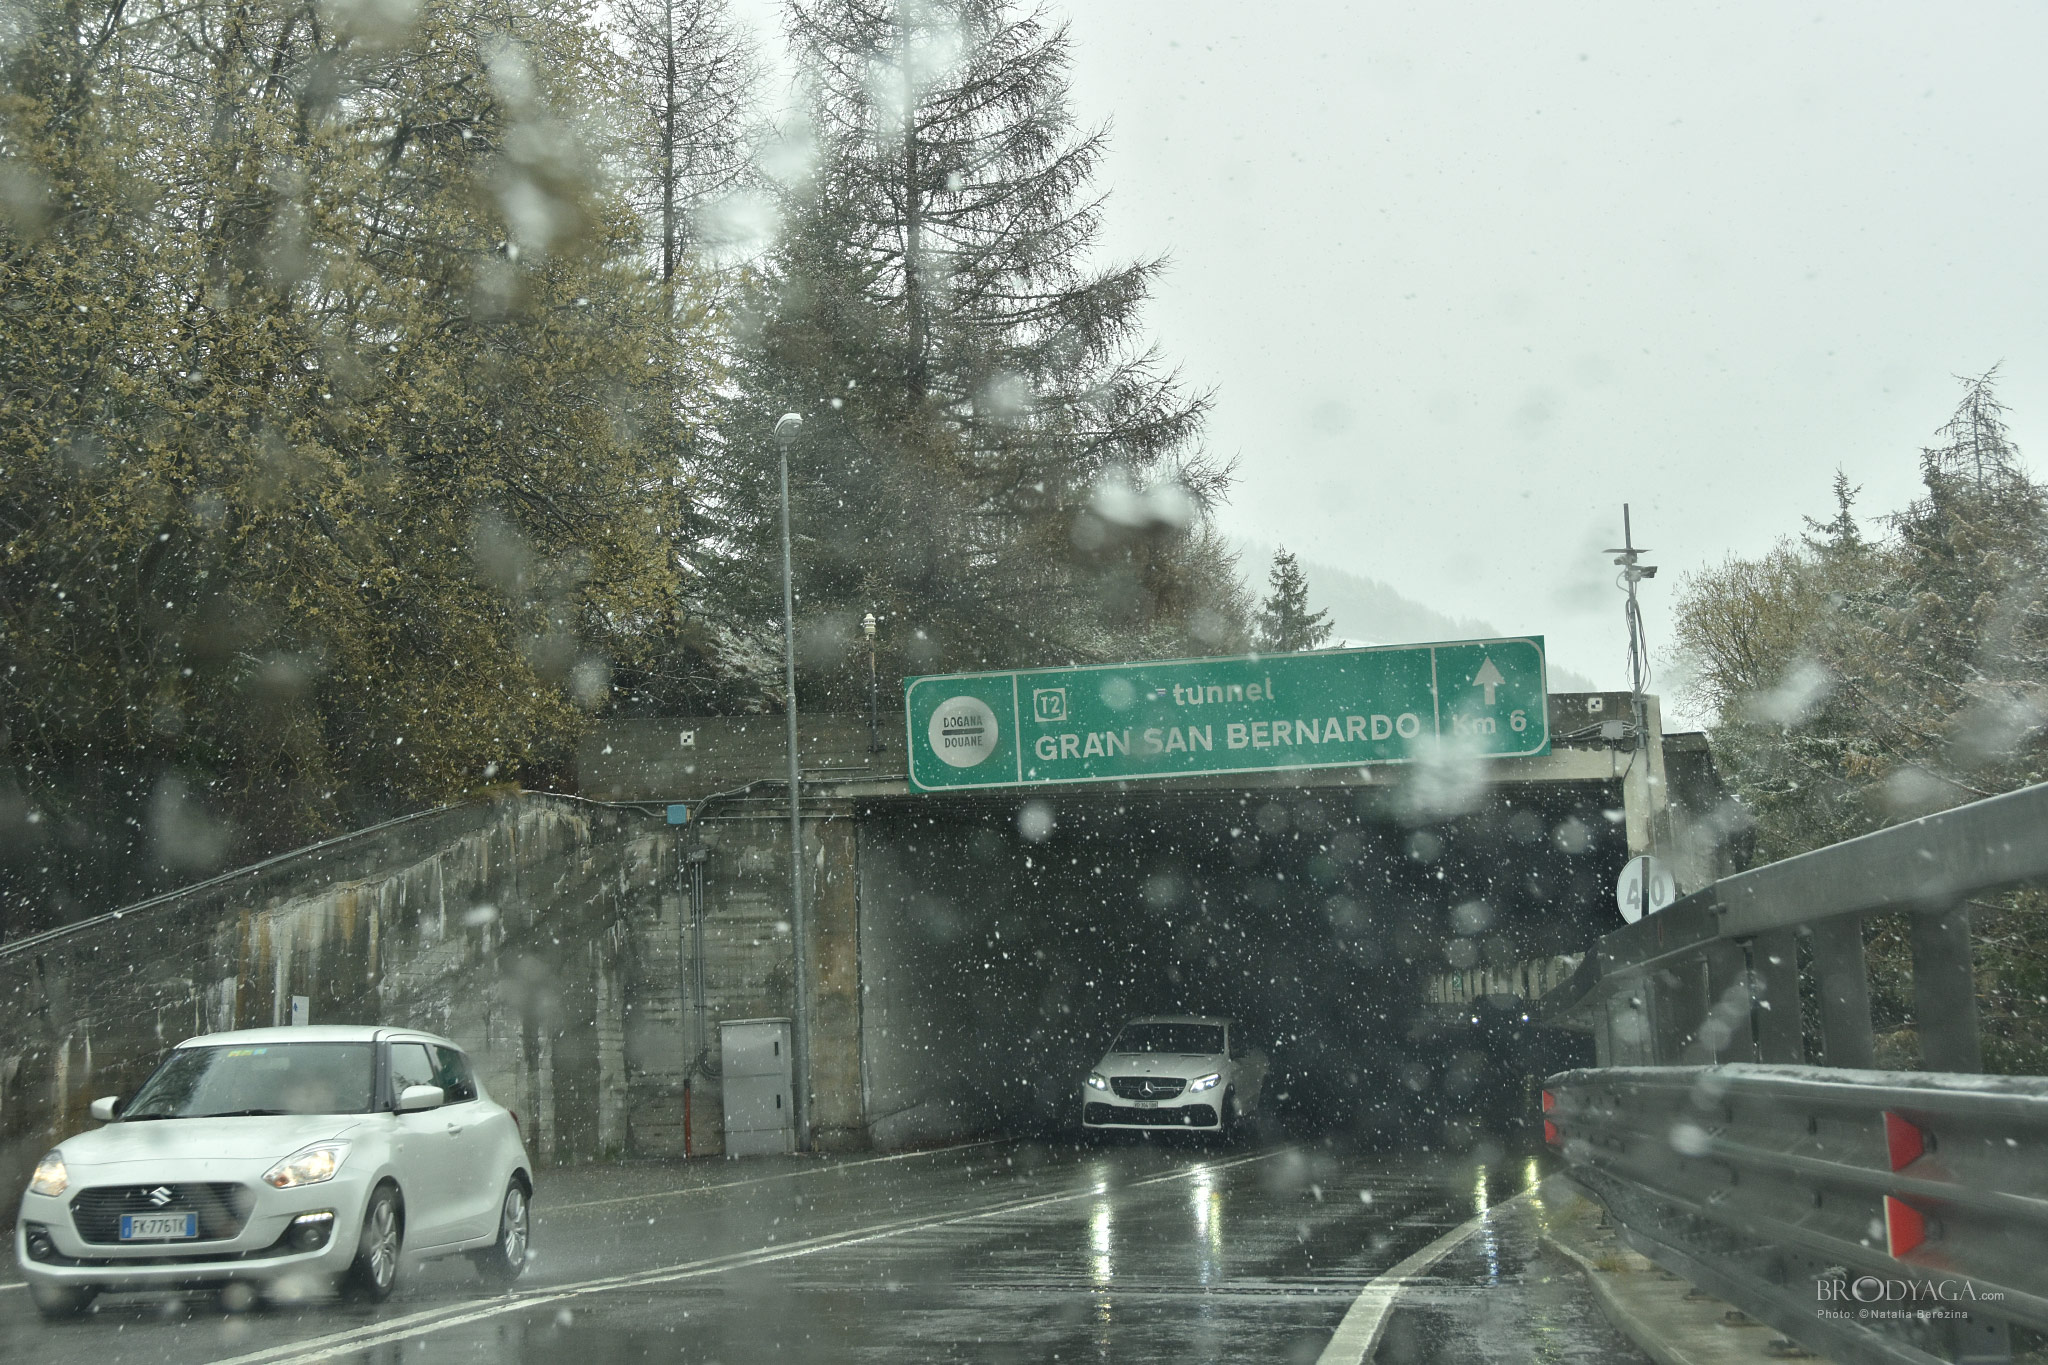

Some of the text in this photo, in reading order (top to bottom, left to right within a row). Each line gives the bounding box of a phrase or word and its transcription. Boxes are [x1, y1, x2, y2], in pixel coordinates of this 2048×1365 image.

[1040, 695, 1061, 714] T2
[1172, 677, 1275, 706] tunnel
[943, 715, 983, 728] DOGANA
[1453, 710, 1528, 737] Km 6
[944, 736, 983, 748] DOUANE
[1035, 712, 1421, 761] GRAN SAN BERNARDO
[1626, 875, 1666, 910] 40
